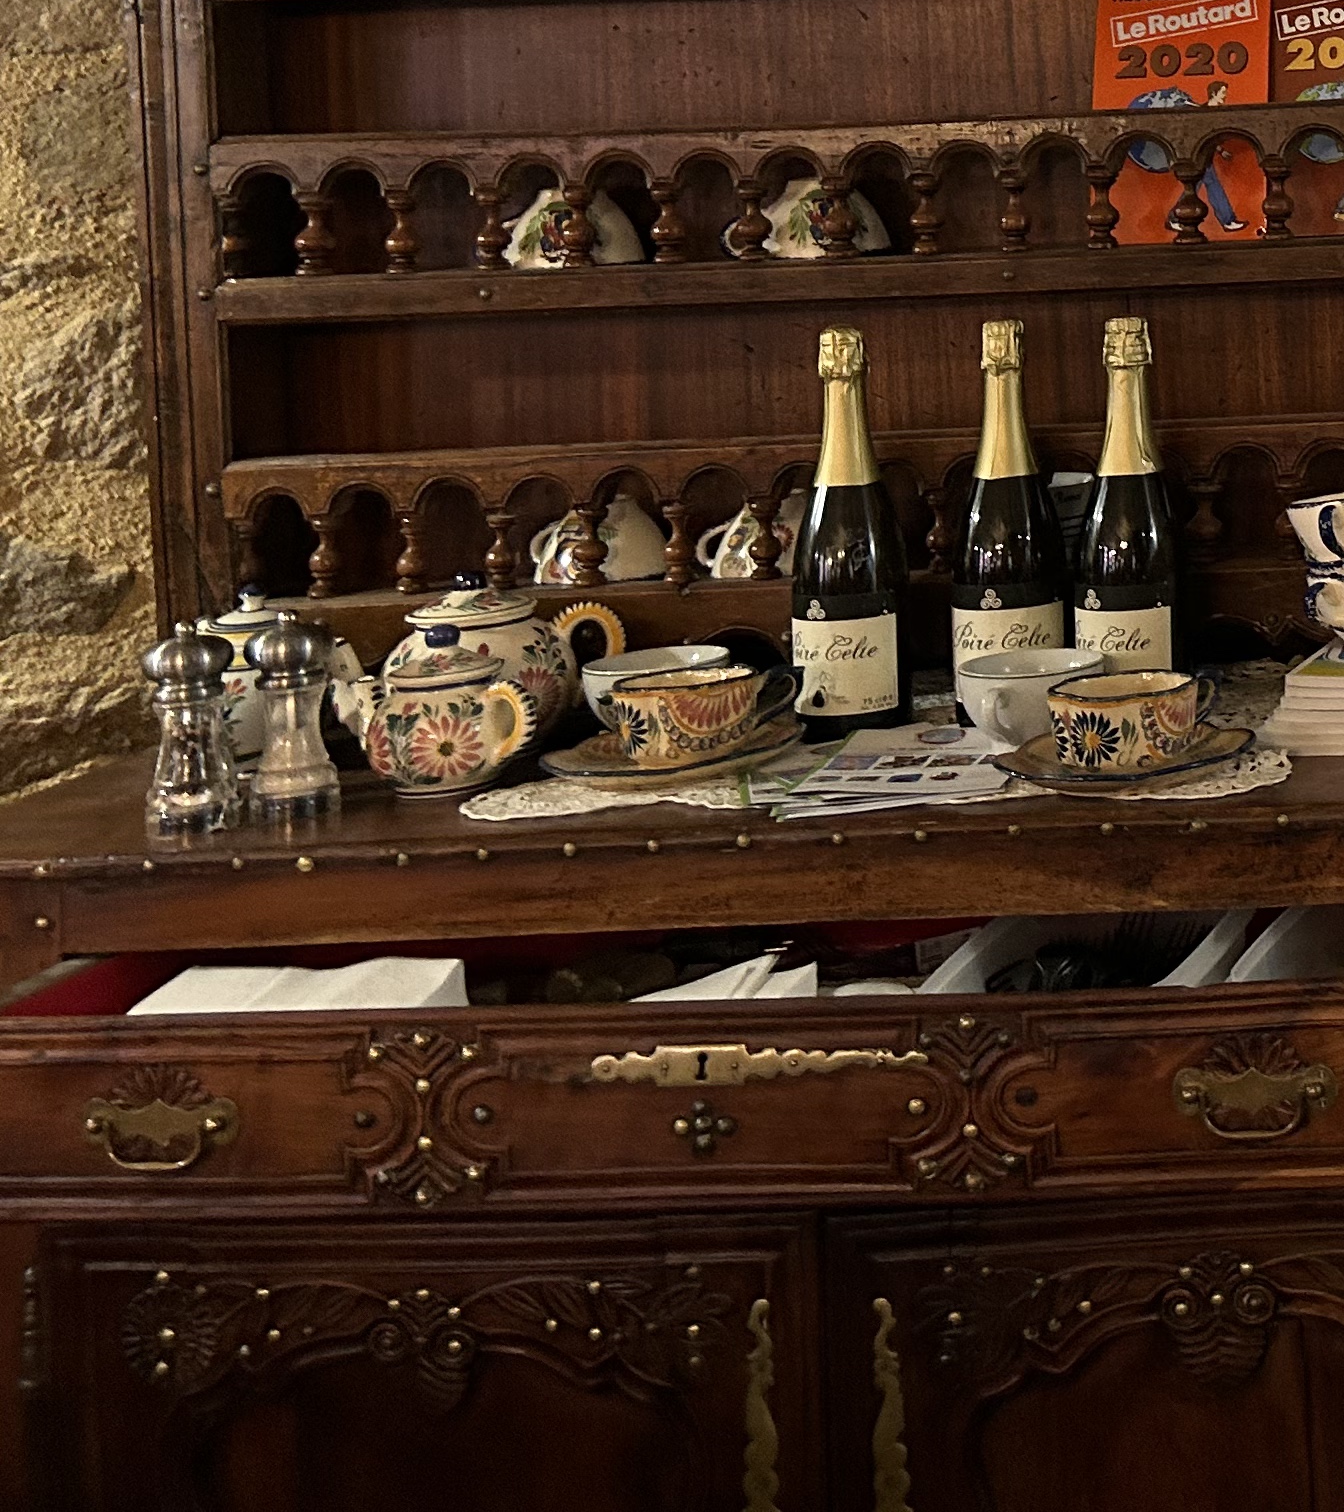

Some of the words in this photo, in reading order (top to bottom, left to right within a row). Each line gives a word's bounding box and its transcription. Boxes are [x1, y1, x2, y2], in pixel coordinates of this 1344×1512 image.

[1115, 41, 1249, 79] 2020
[825, 635, 878, 662] Celte
[954, 621, 994, 651] Poiré
[1001, 623, 1051, 650] Celte
[1100, 626, 1151, 652] Celte
